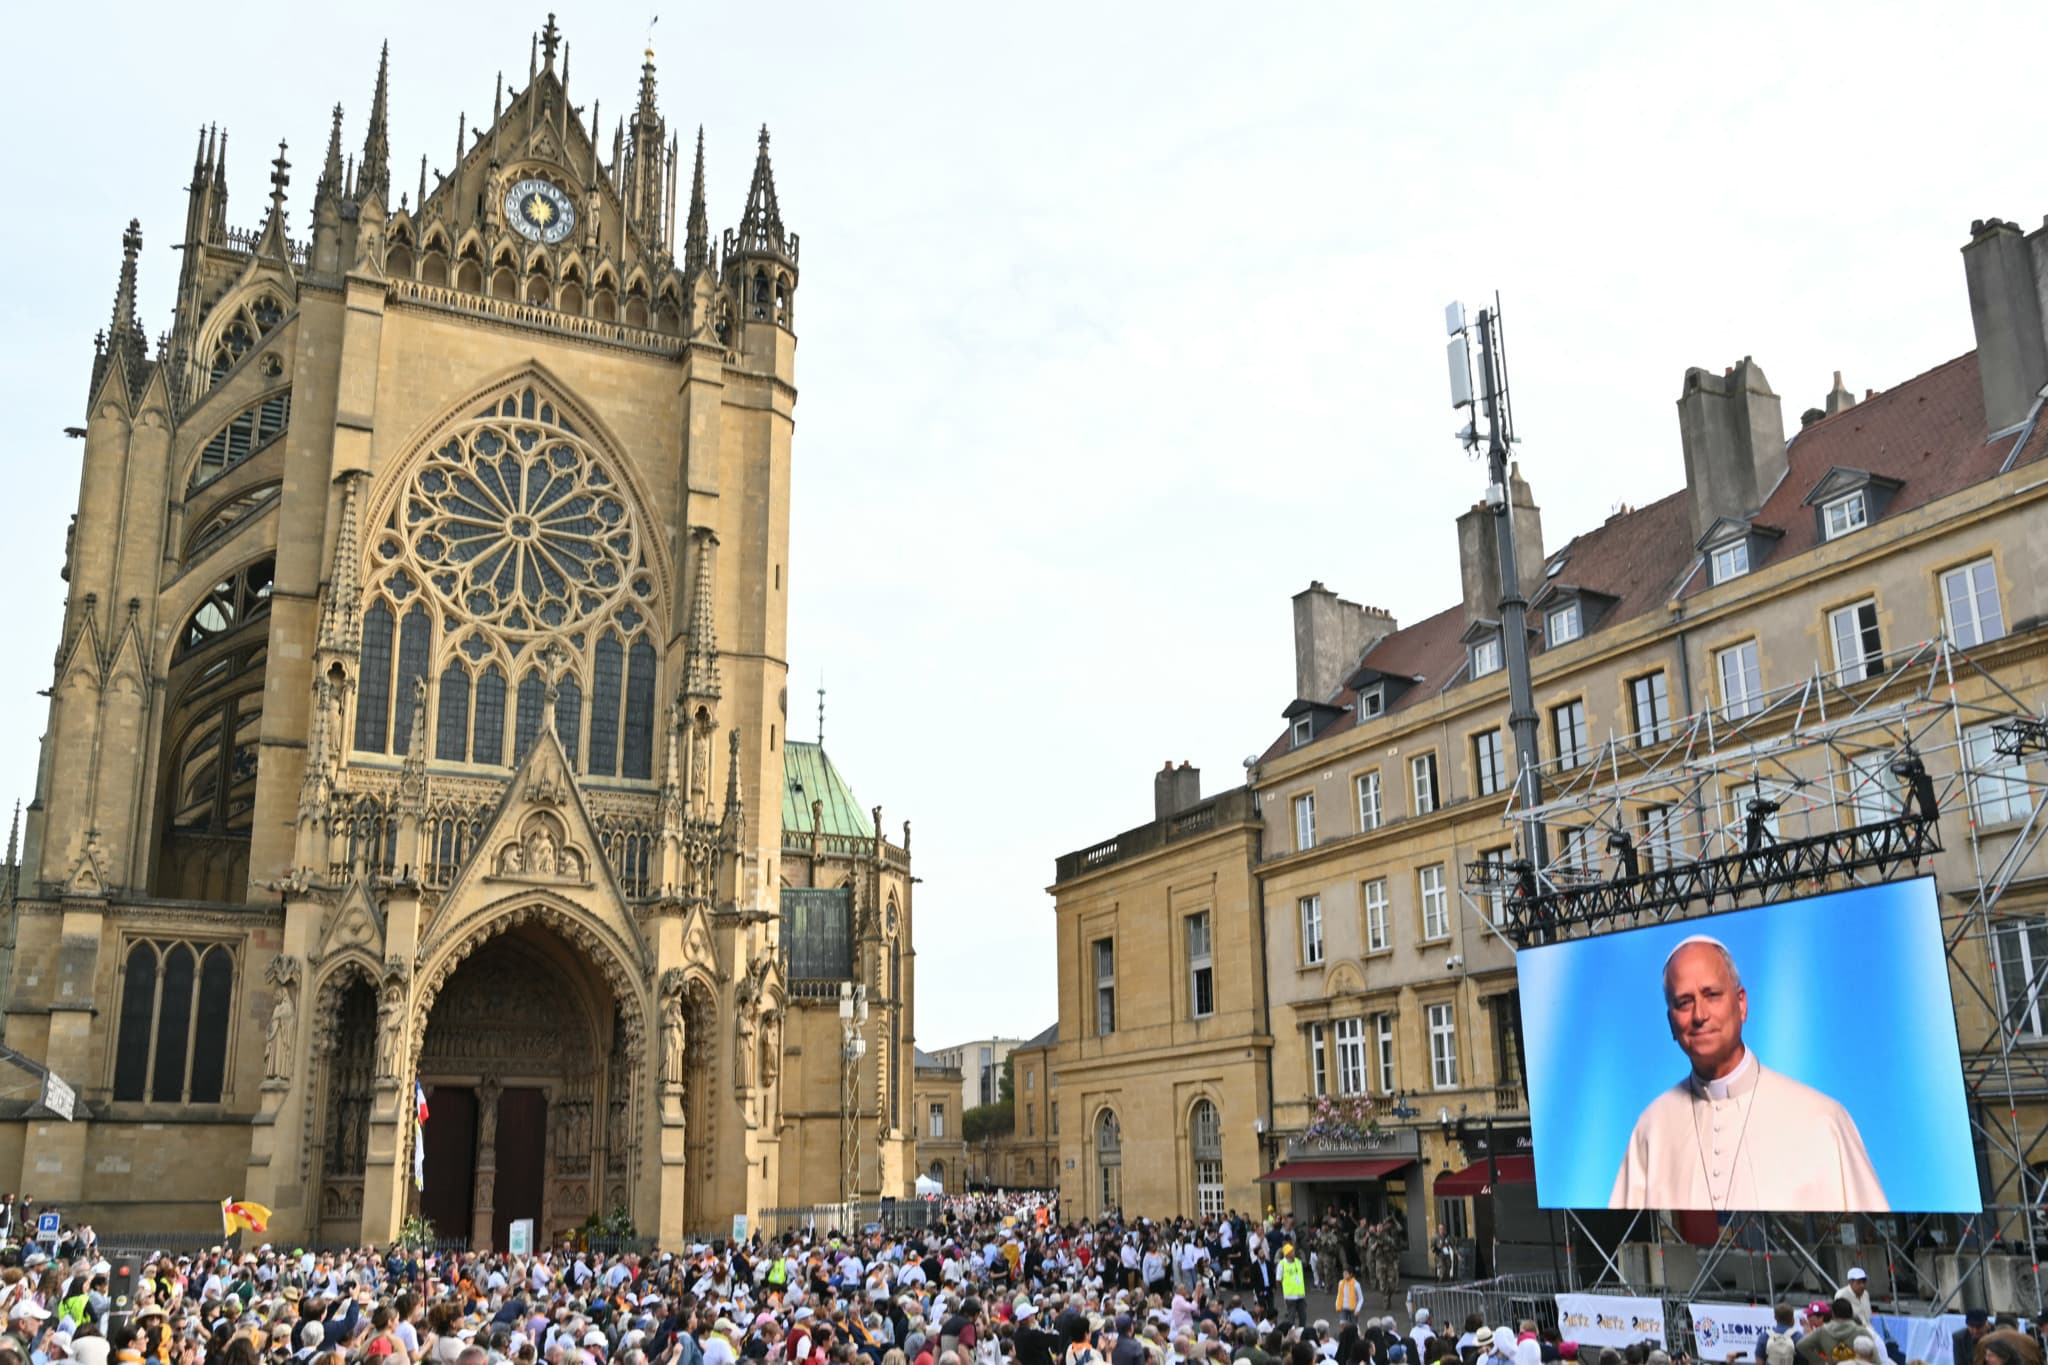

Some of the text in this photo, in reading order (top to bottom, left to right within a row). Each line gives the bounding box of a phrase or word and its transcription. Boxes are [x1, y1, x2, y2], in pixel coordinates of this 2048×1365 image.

[44, 1217, 54, 1230] P
[1563, 1312, 1661, 1332] METZ METZ METZ
